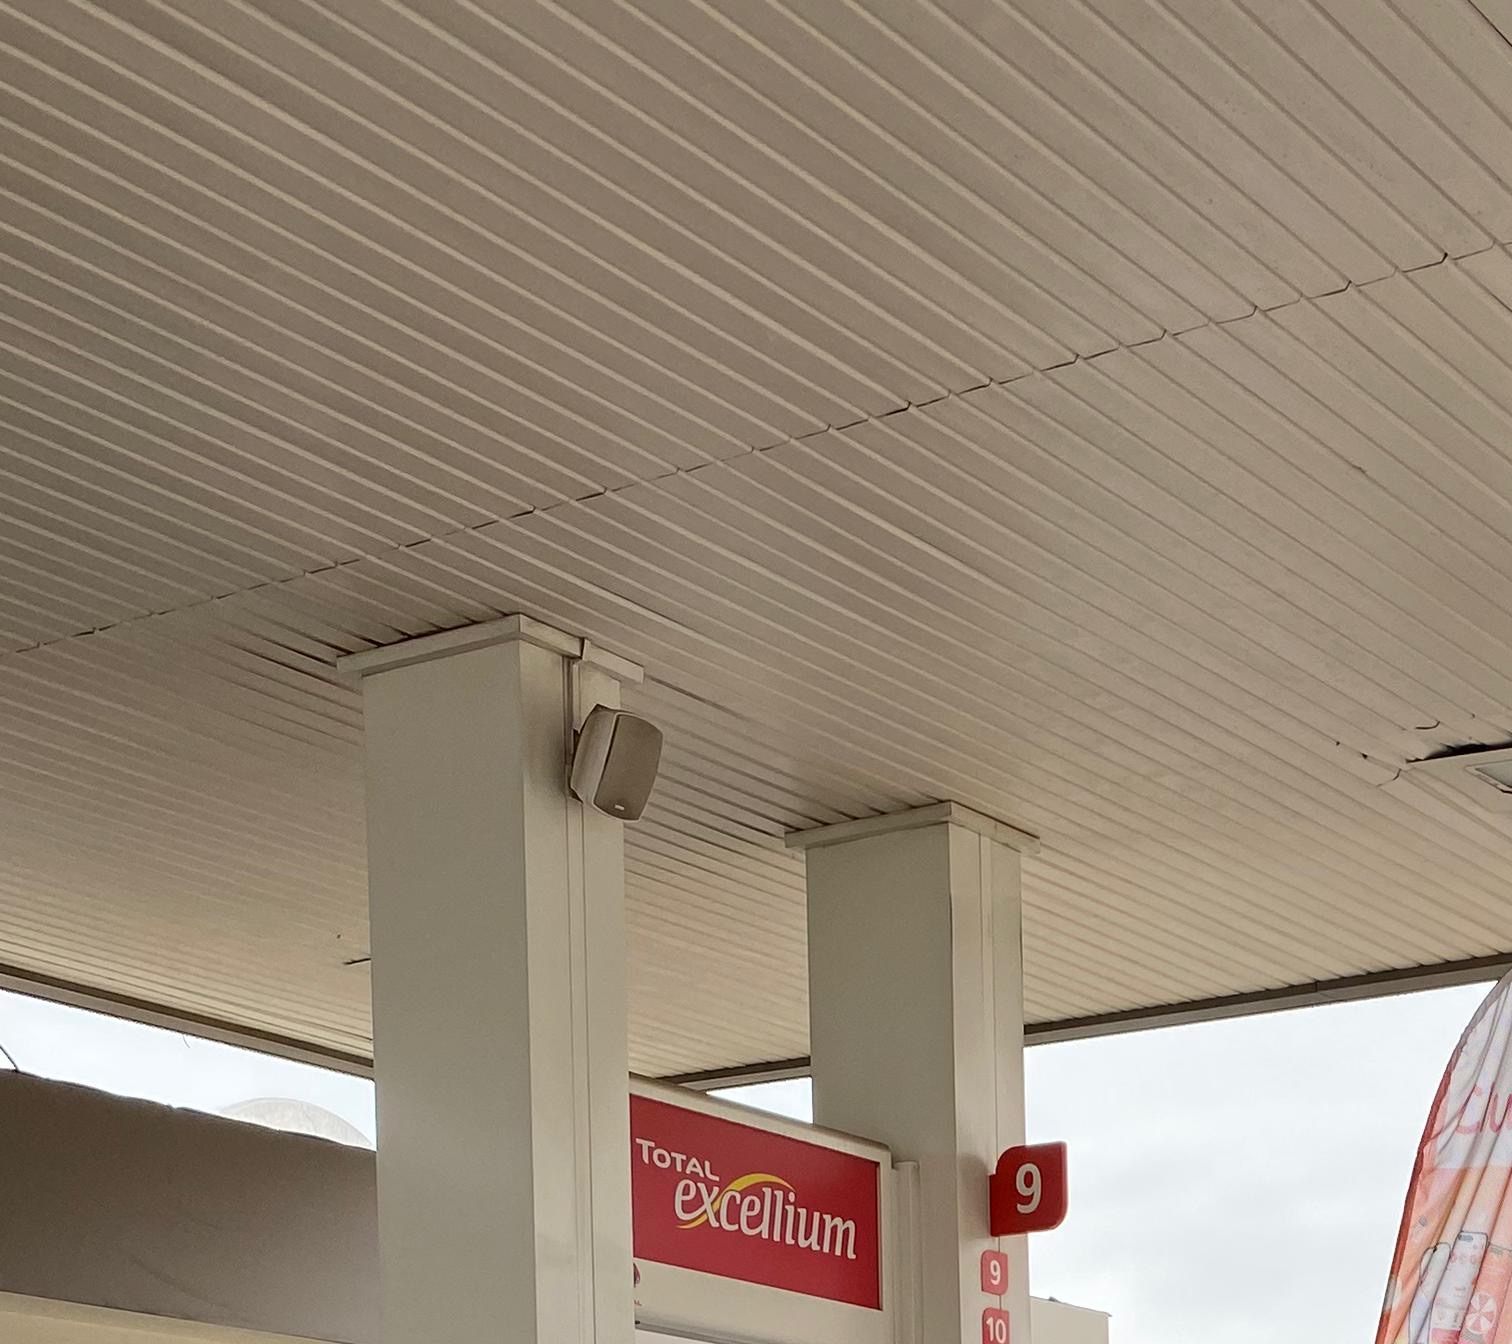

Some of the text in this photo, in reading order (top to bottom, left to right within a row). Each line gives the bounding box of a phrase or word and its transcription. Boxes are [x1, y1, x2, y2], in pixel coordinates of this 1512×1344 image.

[635, 1137, 720, 1182] TOTAL
[1015, 1162, 1042, 1214] 9
[674, 1178, 857, 1260] excellium
[990, 1259, 1001, 1286] 9
[985, 1316, 1007, 1344] 10
